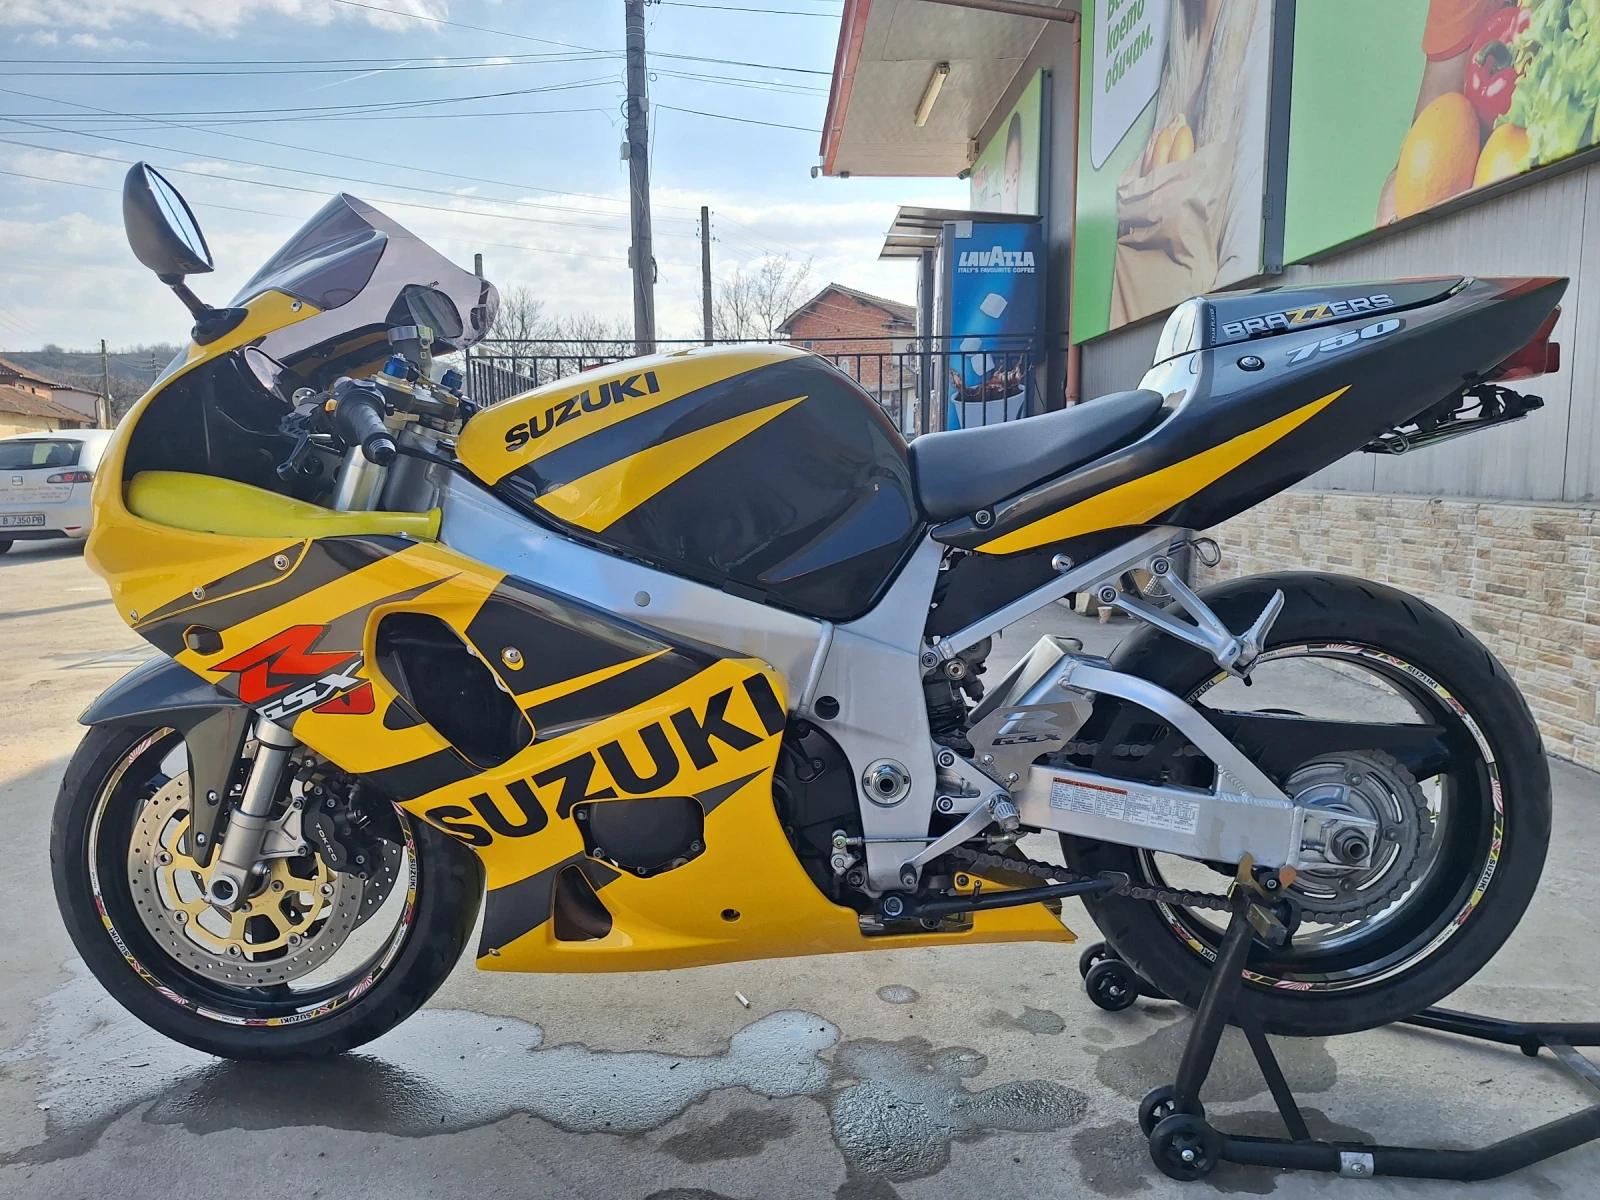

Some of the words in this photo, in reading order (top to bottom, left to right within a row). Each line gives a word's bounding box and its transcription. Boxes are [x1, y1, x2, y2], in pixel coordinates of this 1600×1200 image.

[1105, 23, 1154, 94] обичам.
[958, 246, 1035, 267] LAVAZZA
[1222, 293, 1397, 339] BRAZZERS
[1286, 318, 1402, 364] 750
[505, 371, 661, 452] SUZUKI
[256, 659, 363, 721] GSX
[1185, 679, 1216, 706] SUZUKI
[1405, 665, 1439, 689] SUZUKI
[425, 672, 785, 847] SUZUKI
[315, 822, 338, 862] TOKICO
[408, 857, 416, 890] SUZUKI
[1477, 858, 1496, 892] SUZUKI
[109, 927, 131, 958] SUZUKI
[280, 1013, 312, 1024] SUZUKI
